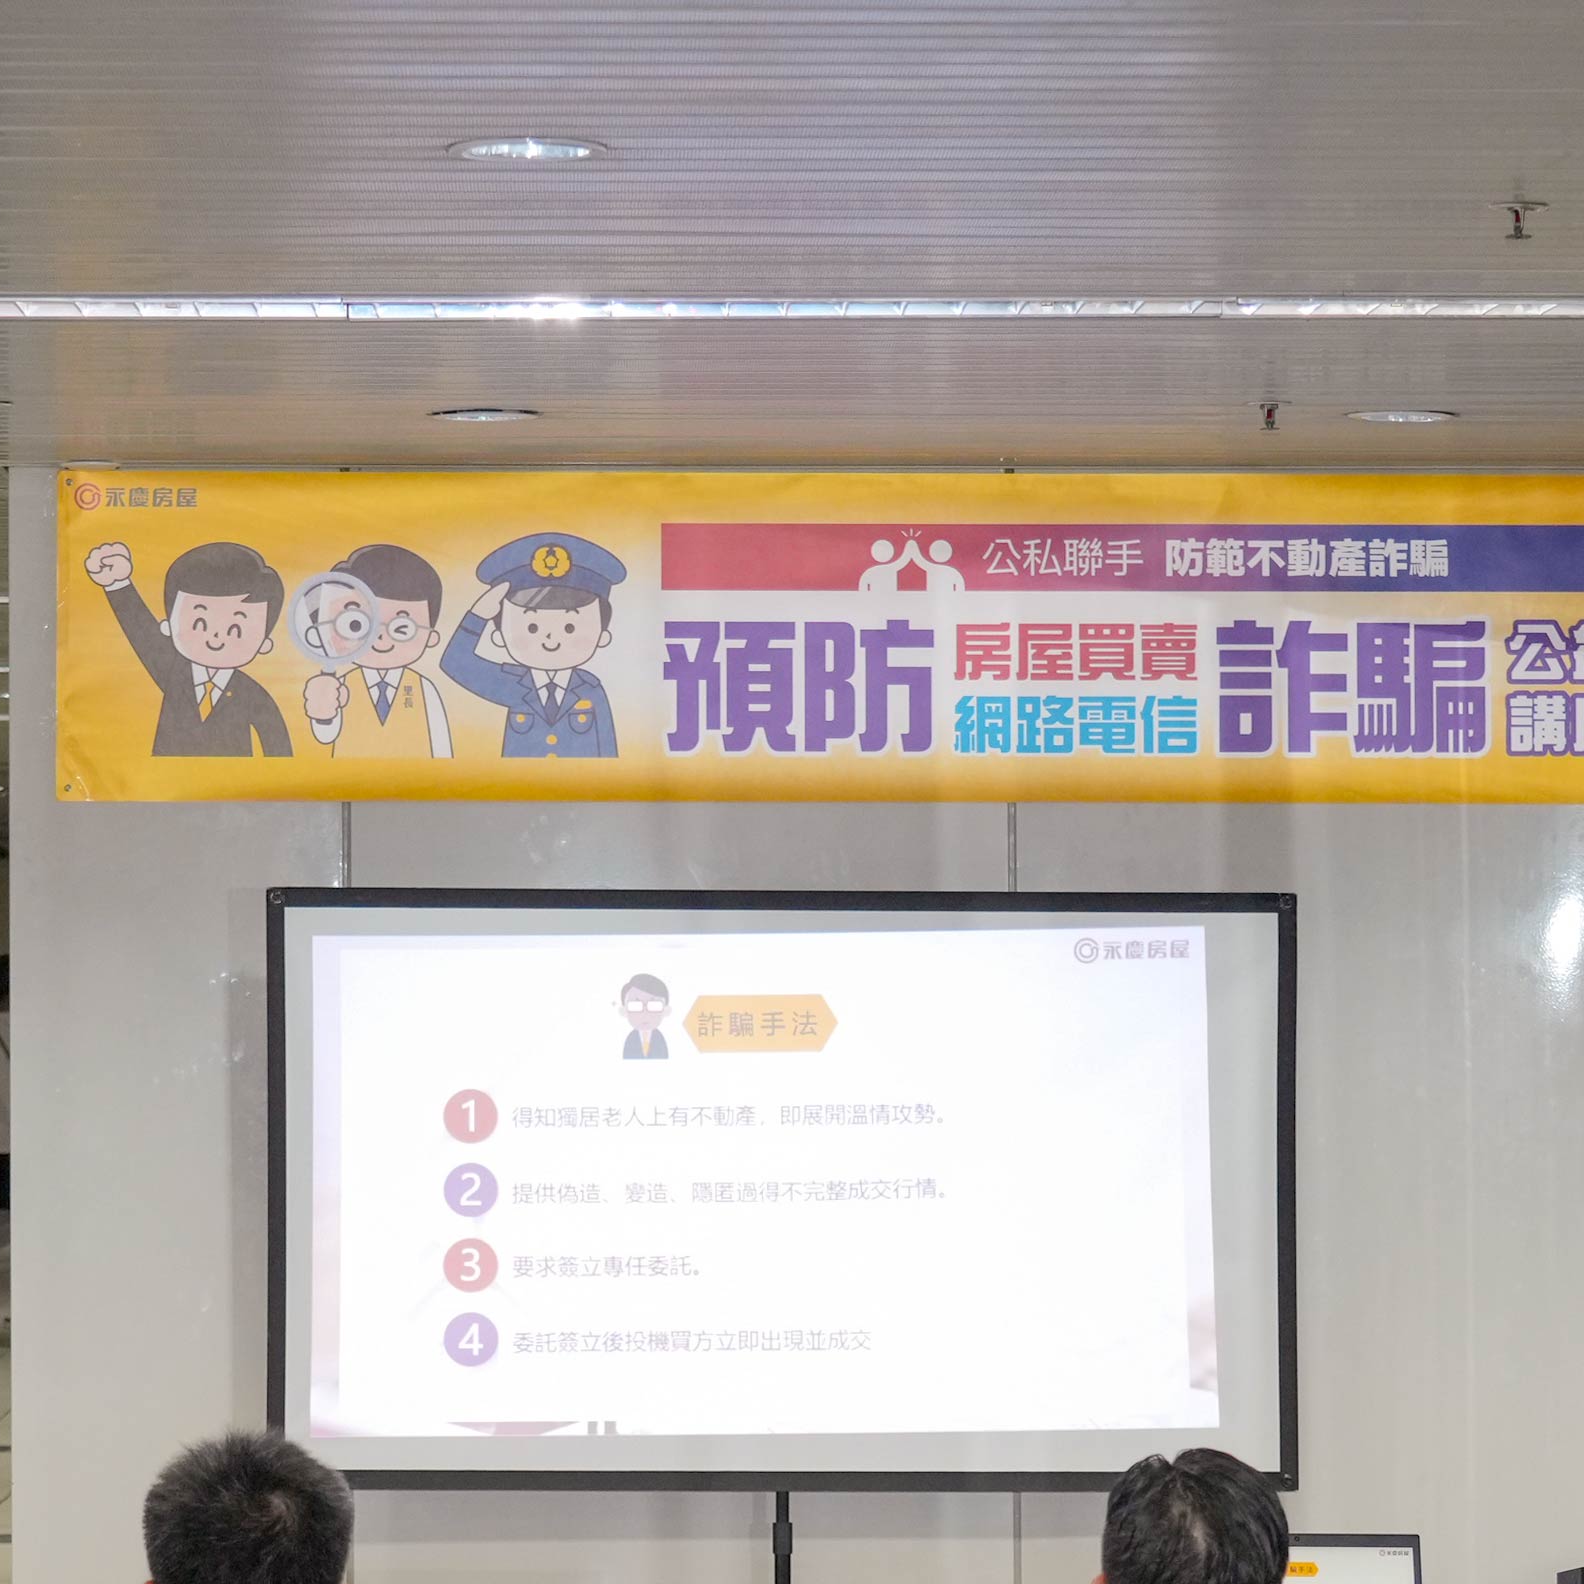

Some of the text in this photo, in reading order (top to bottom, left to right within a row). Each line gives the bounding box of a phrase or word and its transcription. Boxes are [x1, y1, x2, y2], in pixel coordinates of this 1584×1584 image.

[105, 487, 198, 508] 永慶房屋
[983, 537, 1449, 578] 公私聯手 防範不動產詐騙
[953, 623, 1198, 682] 房屋買賣
[661, 620, 934, 753] 預防
[1216, 619, 1487, 753] 詐騙
[953, 695, 1198, 754] 網路電信
[1101, 937, 1191, 962] 永慶房屋
[696, 1009, 819, 1040] 詐騙手法
[461, 1098, 476, 1133] 1
[460, 1171, 482, 1207] 2
[460, 1247, 481, 1282] 3
[458, 1322, 484, 1357] 4
